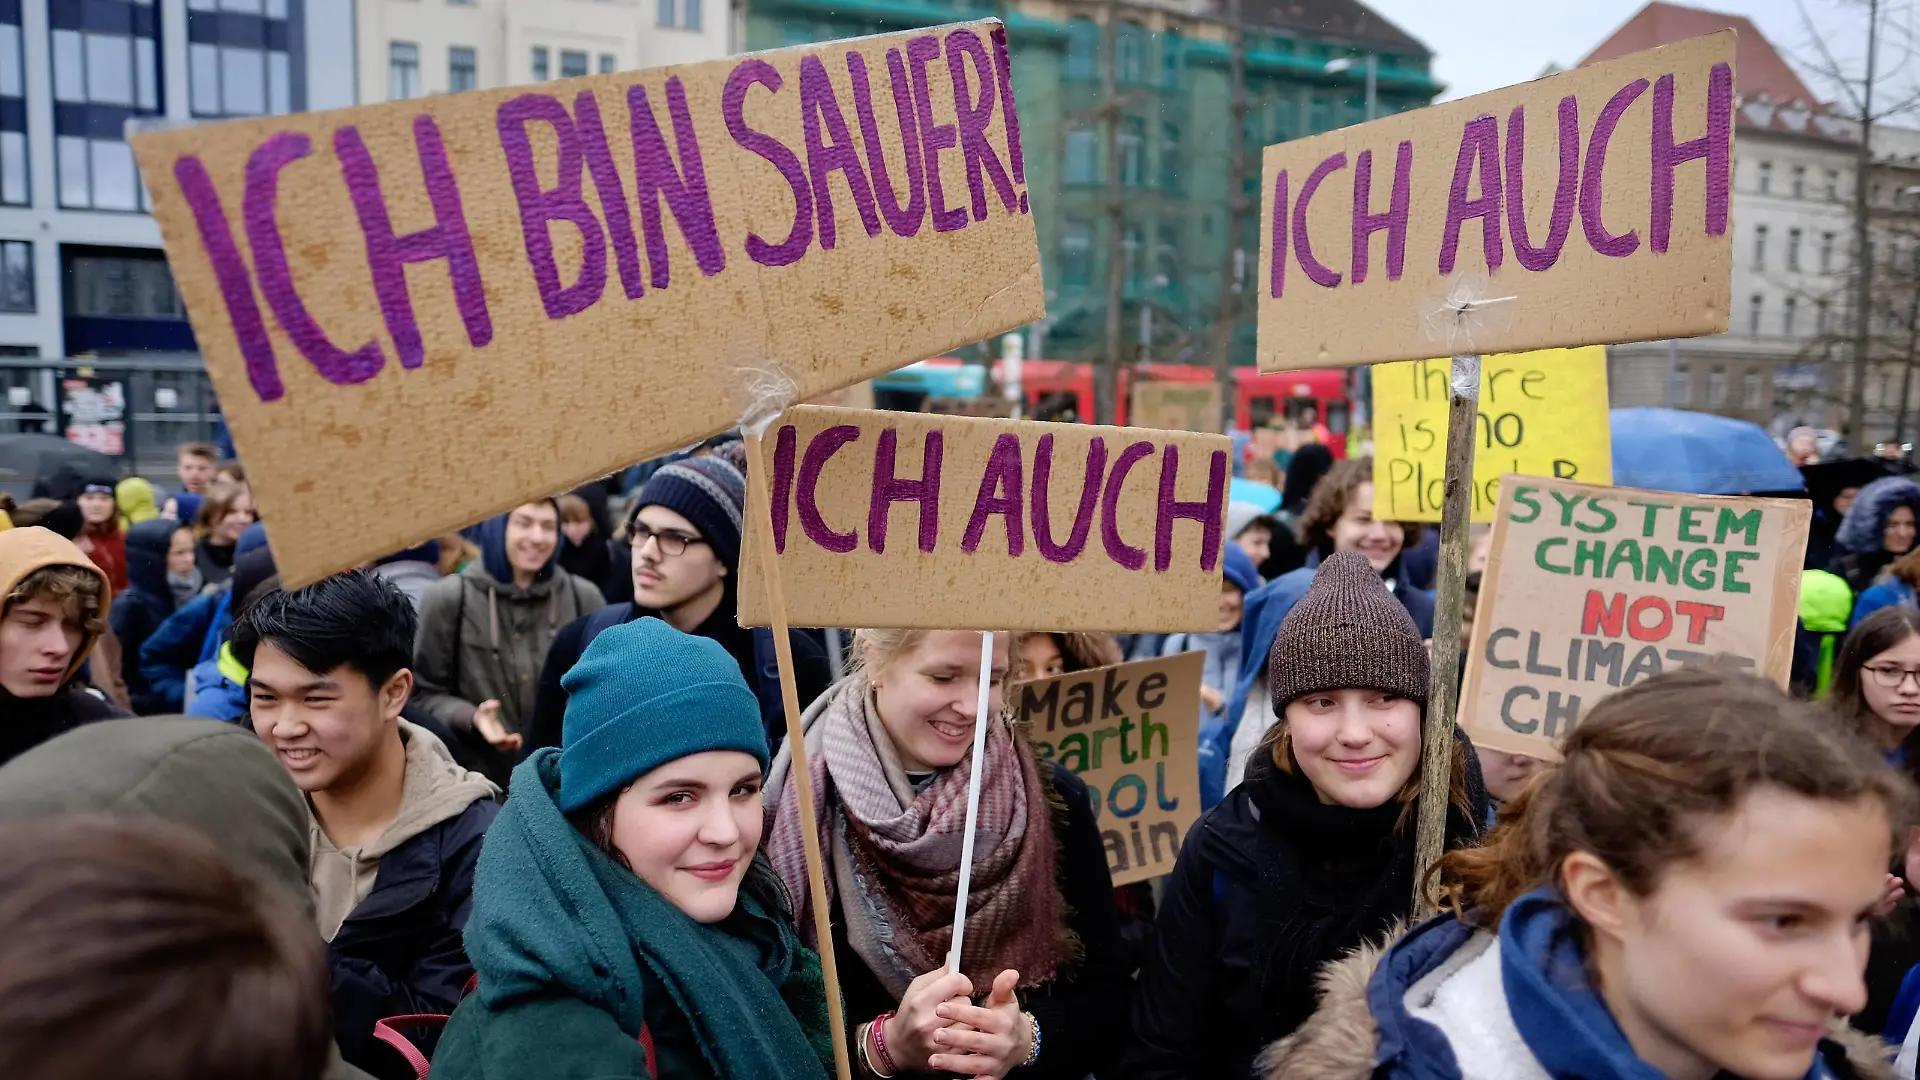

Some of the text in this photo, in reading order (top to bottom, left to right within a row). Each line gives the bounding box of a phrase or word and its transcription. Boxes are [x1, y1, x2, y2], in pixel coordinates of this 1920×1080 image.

[1271, 62, 1733, 299] ICH AUCH
[173, 25, 1030, 402] ICH BIN SAUER!
[1409, 358, 1547, 402] Thre
[1397, 413, 1436, 452] is
[771, 424, 1228, 572] ICH AUCH
[1507, 485, 1763, 546] SYSTEM
[1534, 537, 1760, 593] CHANGE
[1581, 589, 1725, 645] NOT
[1485, 627, 1756, 688] CLIMA
[1020, 668, 1169, 732] Make
